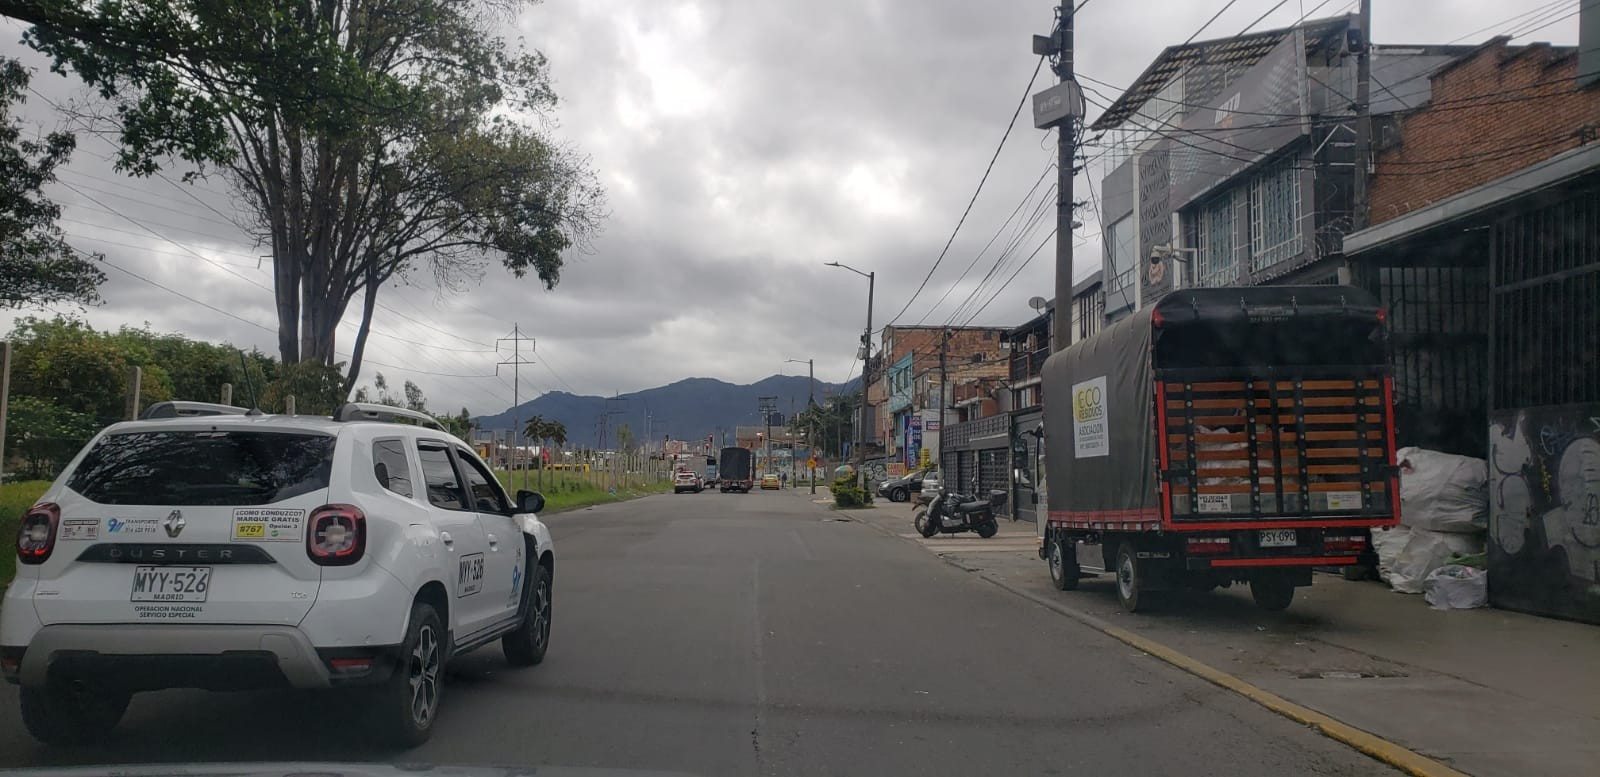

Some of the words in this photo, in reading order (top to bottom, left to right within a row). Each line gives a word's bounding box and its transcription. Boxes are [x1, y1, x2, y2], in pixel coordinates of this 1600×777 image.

[1078, 386, 1102, 409] ECO
[110, 548, 232, 559] DUSTER
[154, 593, 185, 601] MADRID
[135, 605, 170, 613] OPERACION
[139, 611, 168, 619] SERVICIO
[168, 611, 196, 619] ESPECIAL
